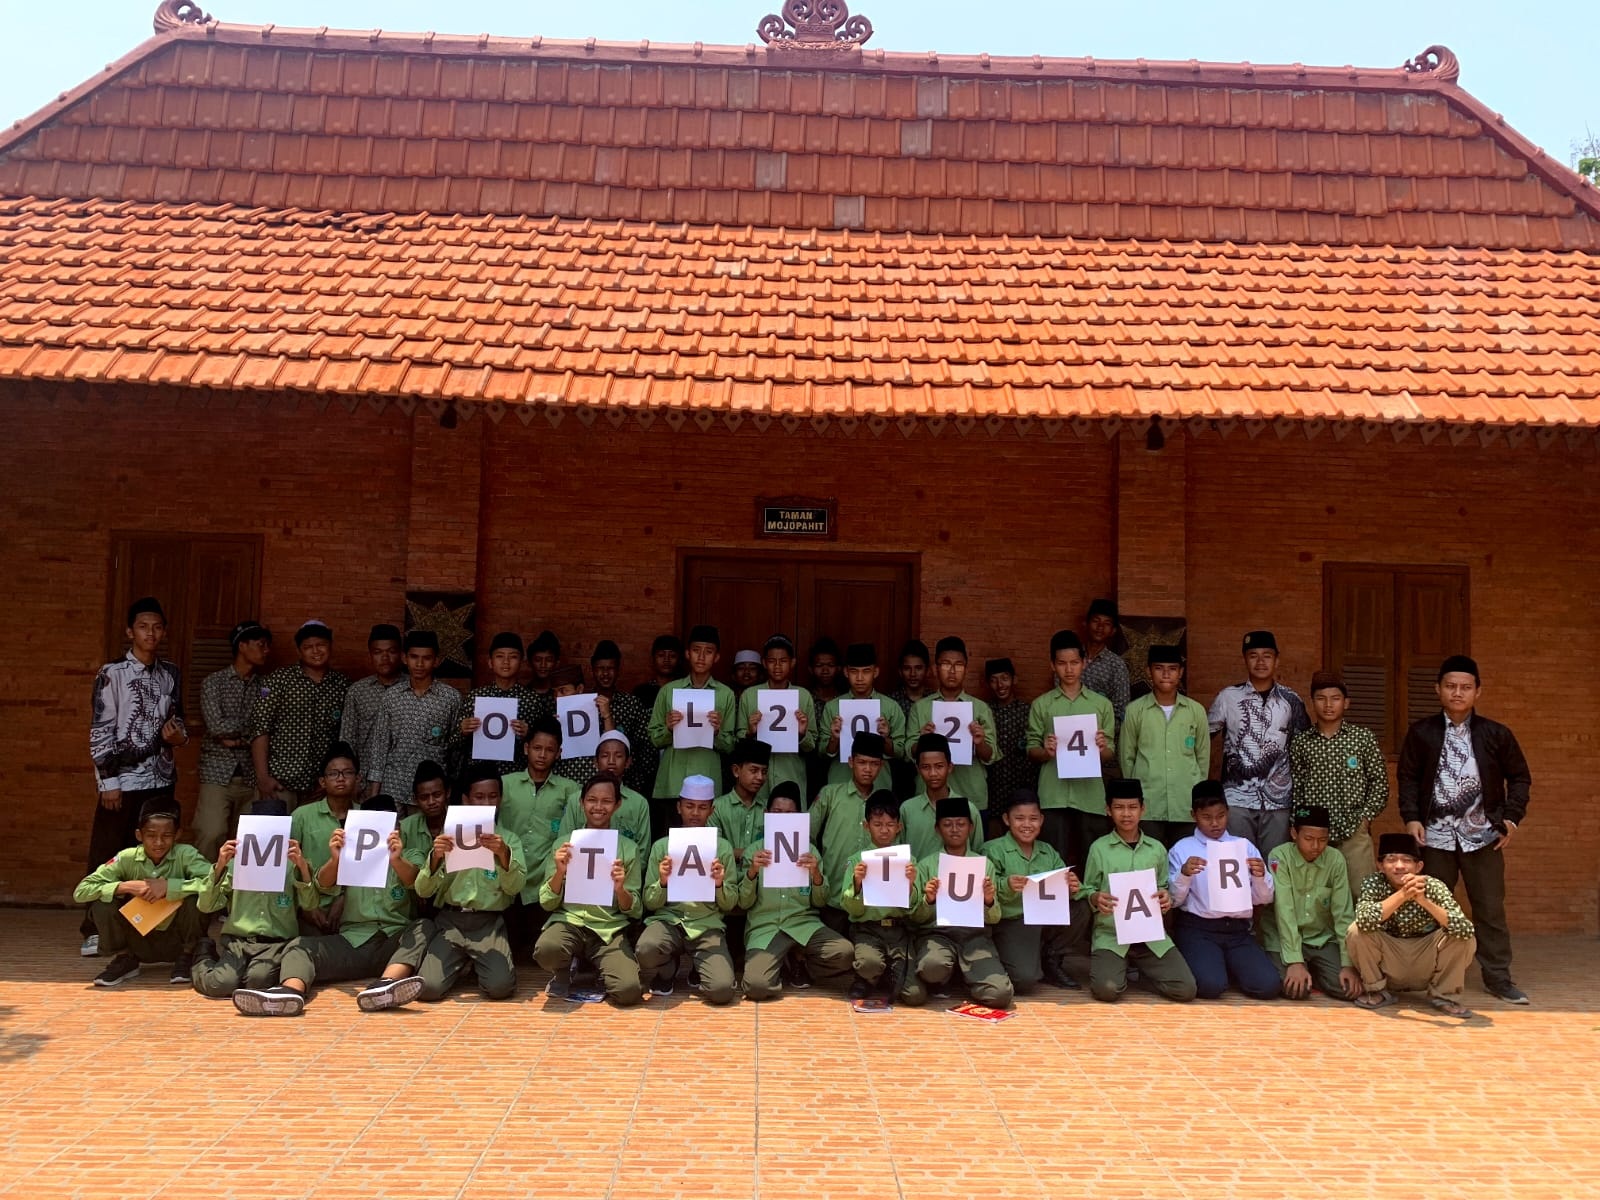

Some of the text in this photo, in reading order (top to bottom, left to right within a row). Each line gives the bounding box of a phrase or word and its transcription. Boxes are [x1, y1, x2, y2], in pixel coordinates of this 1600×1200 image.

[767, 521, 824, 531] MOJOPAHIT
[779, 511, 813, 520] TAMAN
[483, 712, 508, 740] O
[566, 709, 590, 737] D
[686, 701, 703, 727] L
[768, 704, 787, 731] 2
[944, 716, 961, 743] 2
[1067, 730, 1088, 756] 4
[240, 834, 283, 867] M
[355, 828, 380, 861] P
[456, 824, 482, 850] U
[774, 831, 799, 864] N
[580, 848, 604, 879] T
[677, 845, 706, 876] A
[874, 852, 897, 882] T
[1219, 858, 1242, 889] R
[948, 872, 975, 902] U
[1039, 879, 1055, 900] L
[1124, 888, 1152, 920] A
